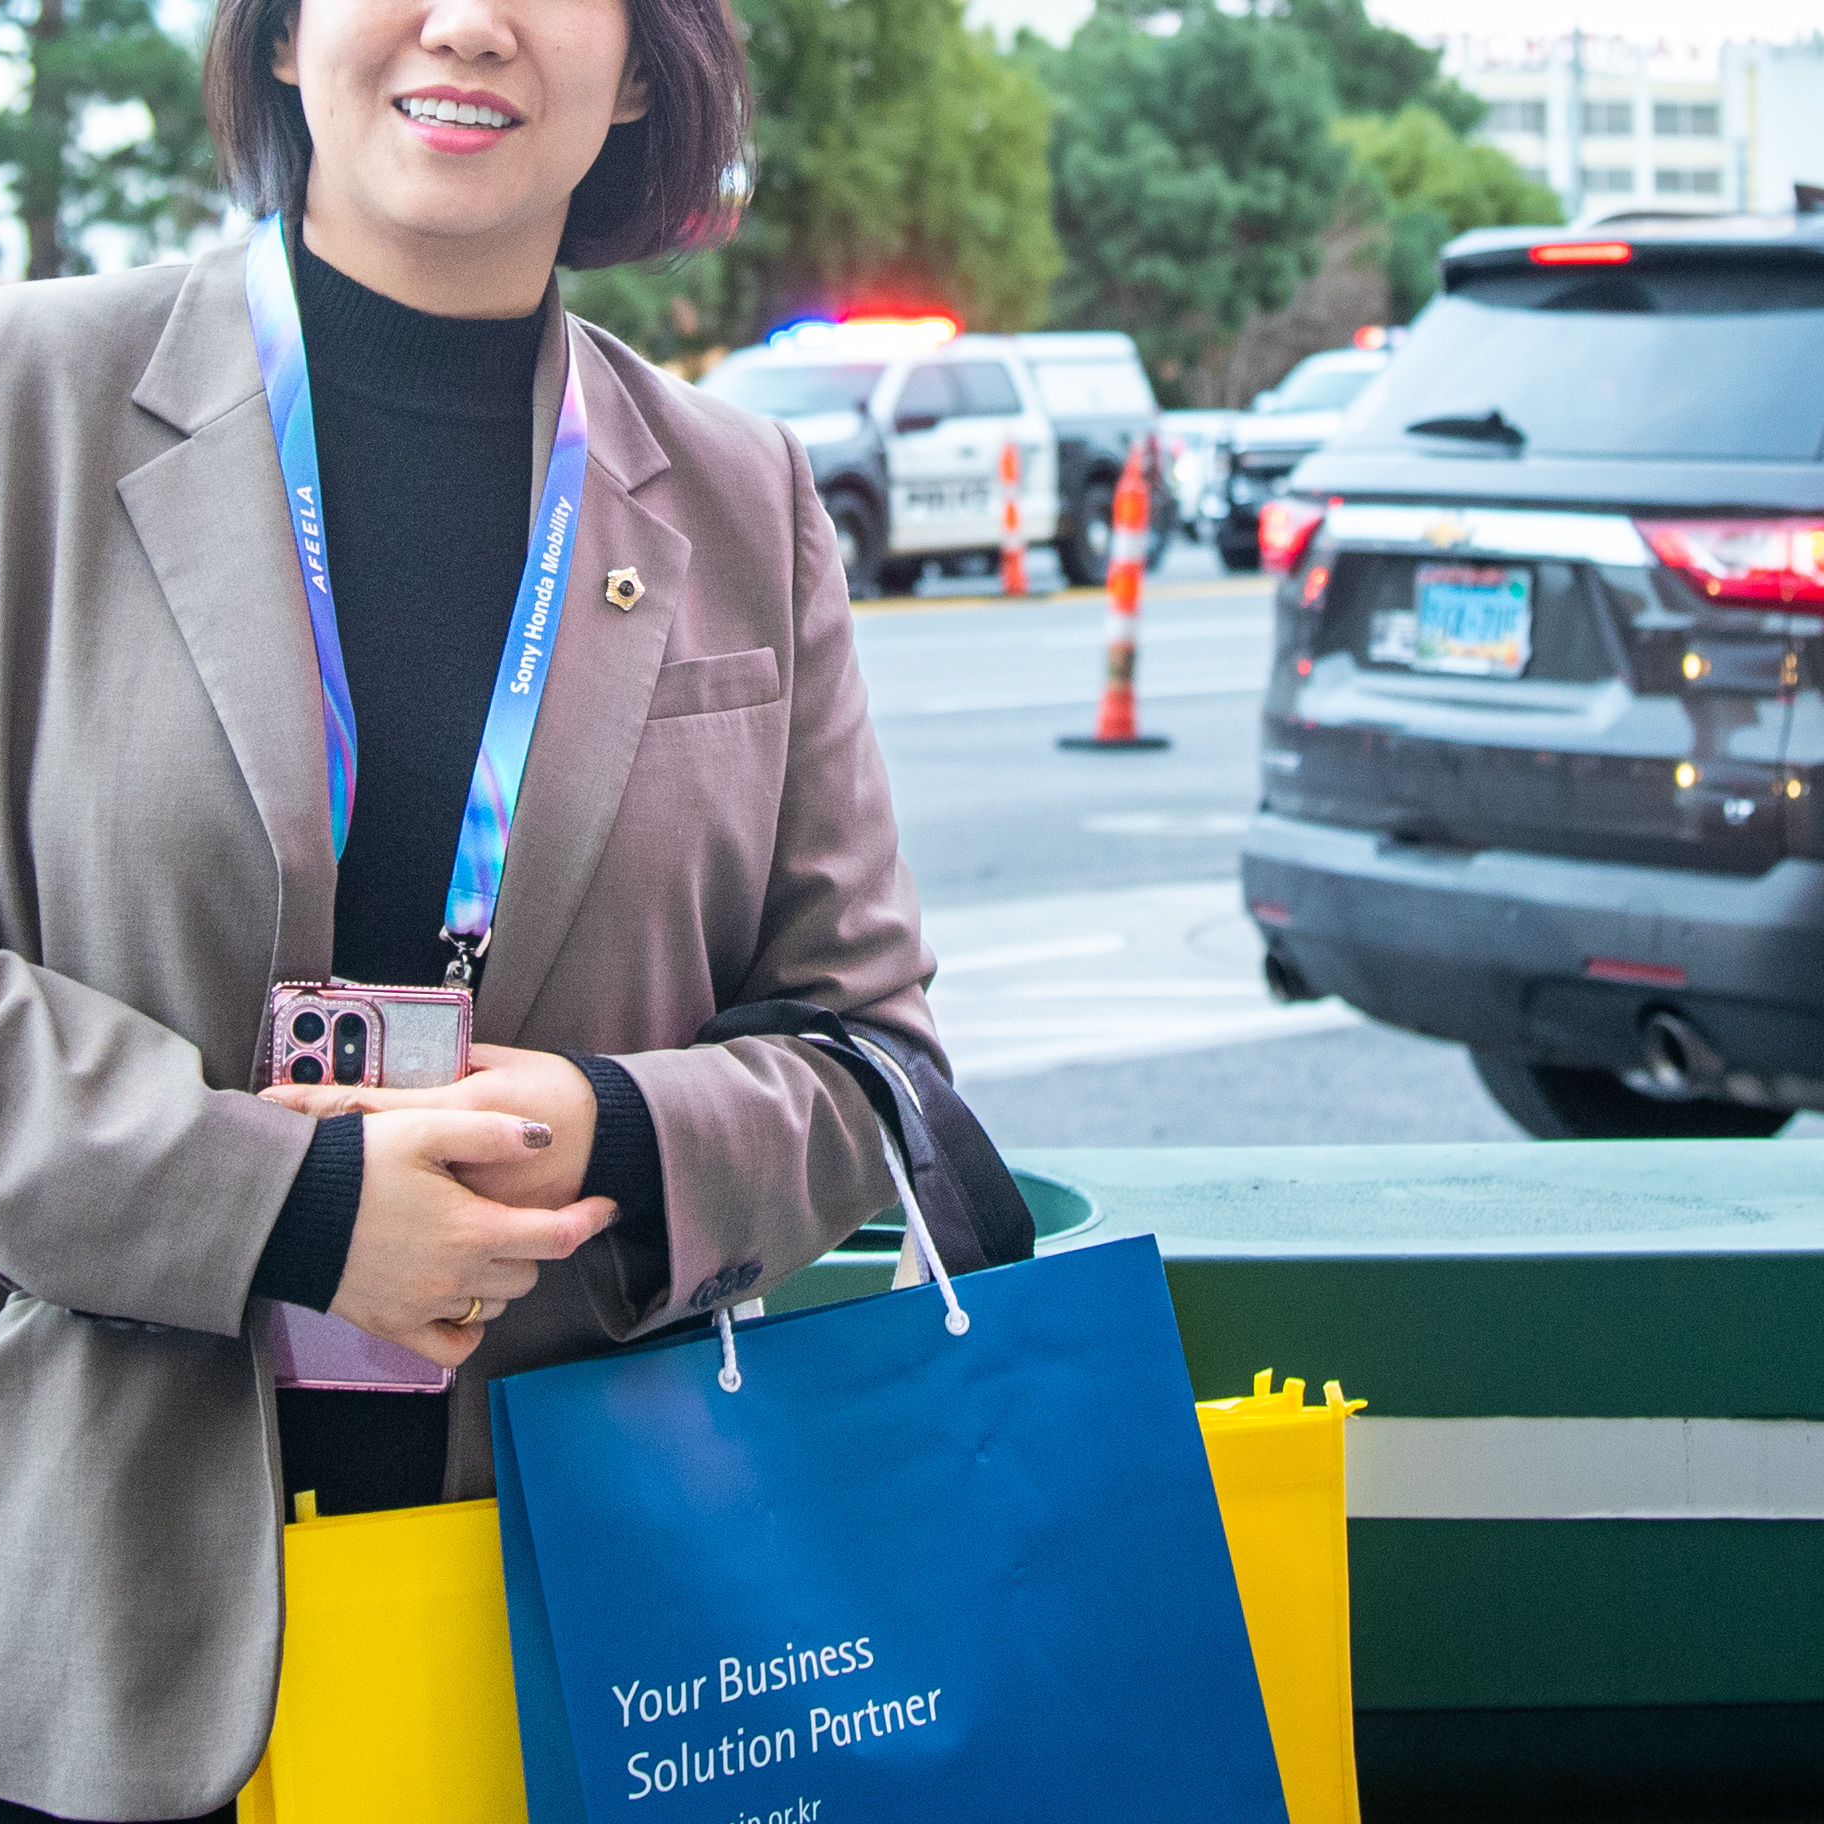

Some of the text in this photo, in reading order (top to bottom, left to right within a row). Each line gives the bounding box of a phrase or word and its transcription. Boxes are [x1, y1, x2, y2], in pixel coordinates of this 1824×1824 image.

[296, 485, 327, 594] AFEELA
[510, 495, 574, 695] Sony Honda Mobility
[611, 1637, 875, 1728] Your Business
[627, 1688, 942, 1801] Solution Partner
